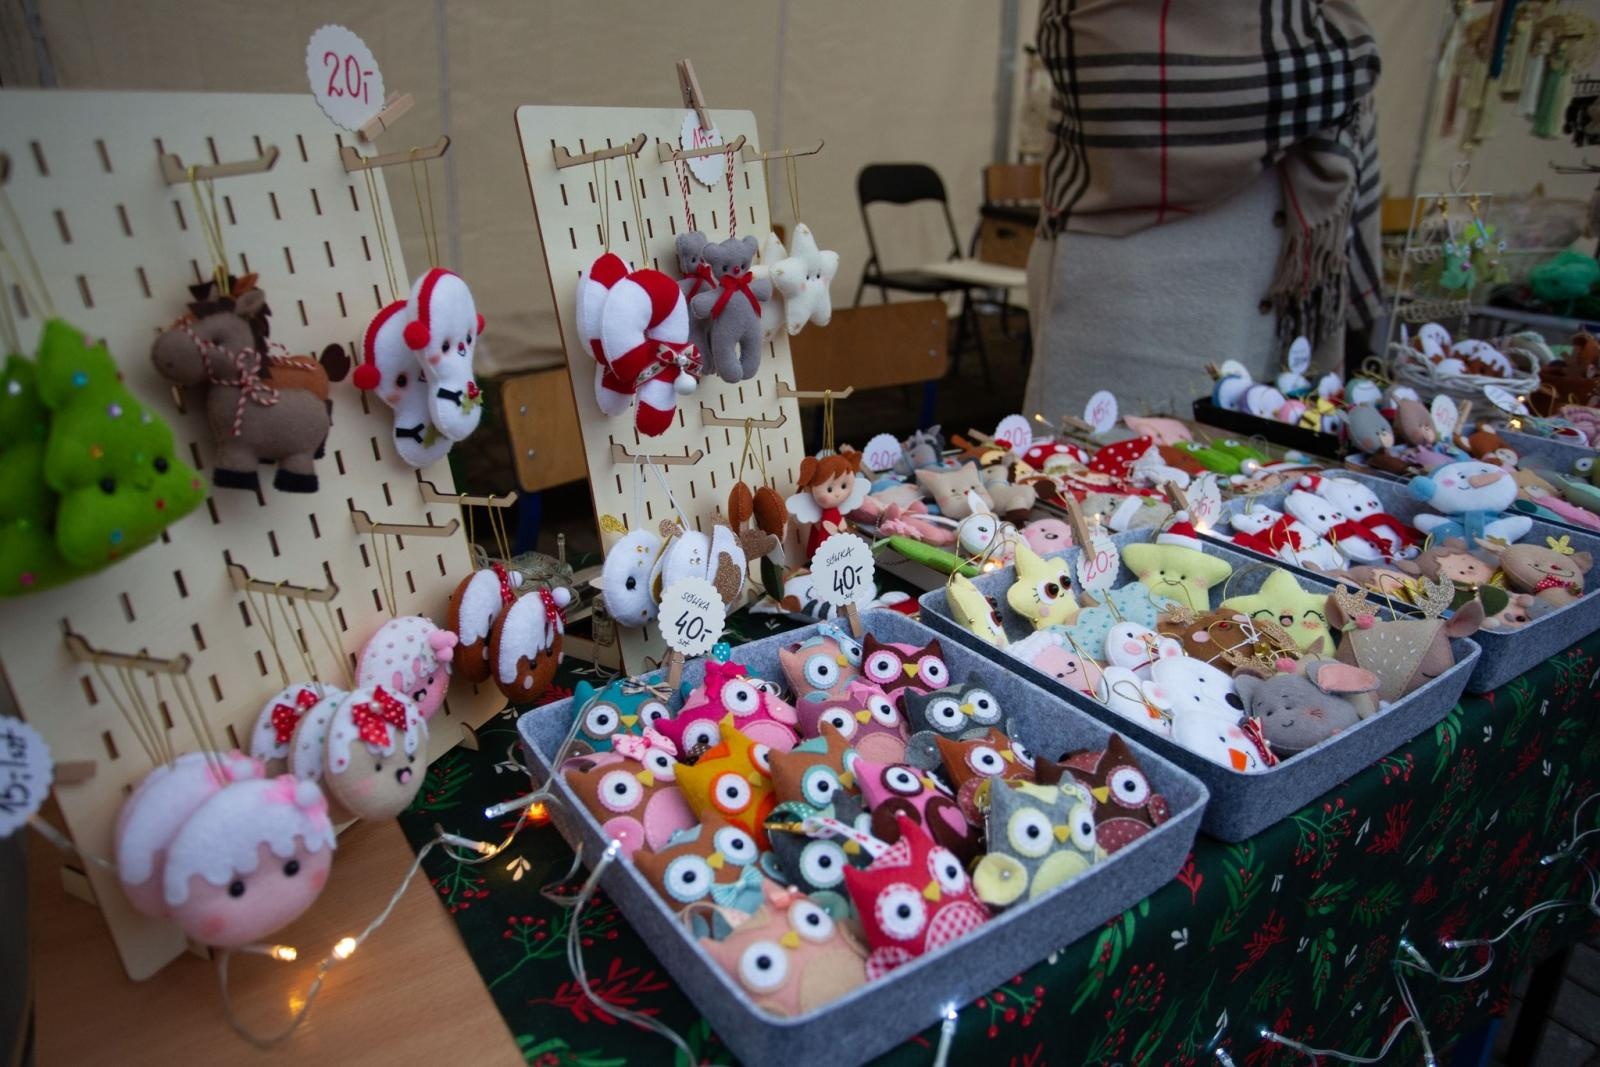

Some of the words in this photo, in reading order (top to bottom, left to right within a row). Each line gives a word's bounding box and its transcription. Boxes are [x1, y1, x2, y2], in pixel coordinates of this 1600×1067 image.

[323, 50, 374, 106] 20,-
[825, 546, 855, 567] SÓWKA
[1083, 550, 1116, 583] 20,-
[833, 565, 863, 596] 40,-
[680, 591, 711, 612] SÓWKA
[675, 610, 713, 643] 40,-
